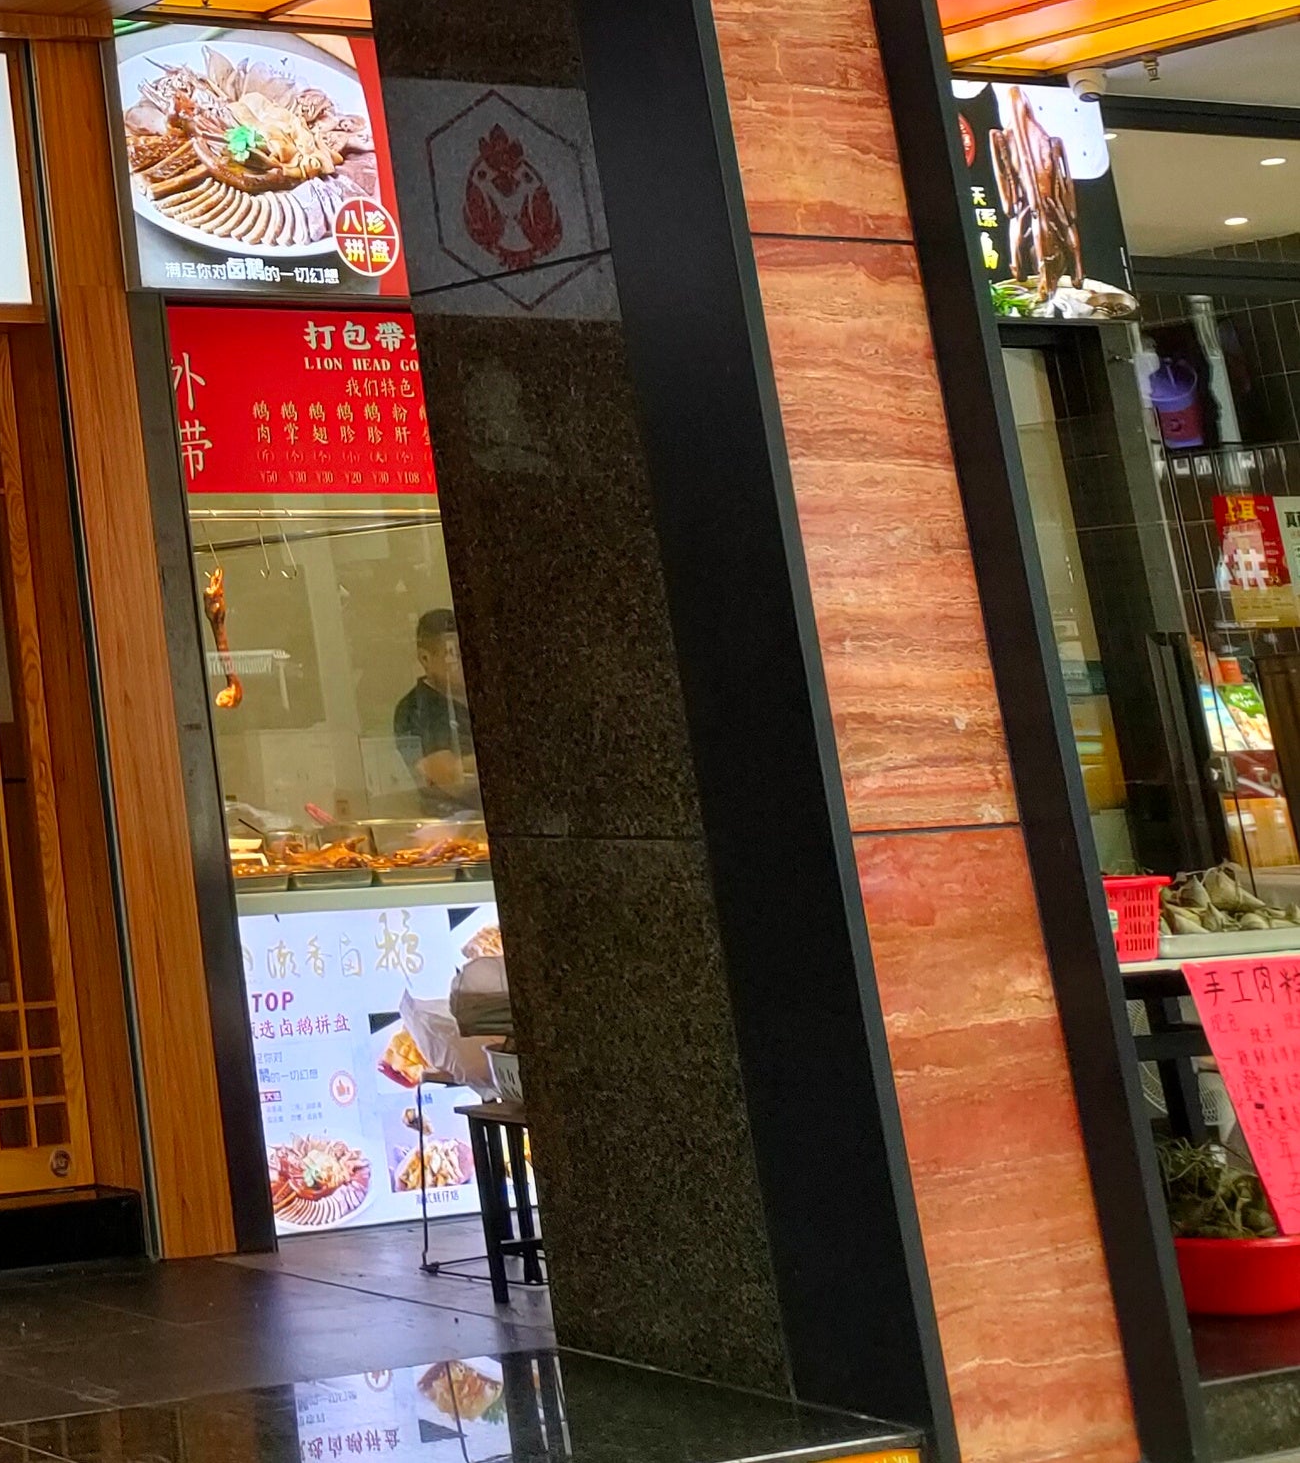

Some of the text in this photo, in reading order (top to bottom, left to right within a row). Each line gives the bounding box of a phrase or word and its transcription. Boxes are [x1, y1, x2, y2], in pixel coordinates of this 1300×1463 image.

[343, 210, 386, 233] 八珍
[344, 239, 391, 262] 拼盘
[165, 257, 340, 284] 满足你对卤鹅的一切幻想
[303, 321, 417, 353] 打包帶
[304, 356, 342, 370] LION
[352, 358, 391, 372] HEAD
[251, 991, 294, 1013] TOP
